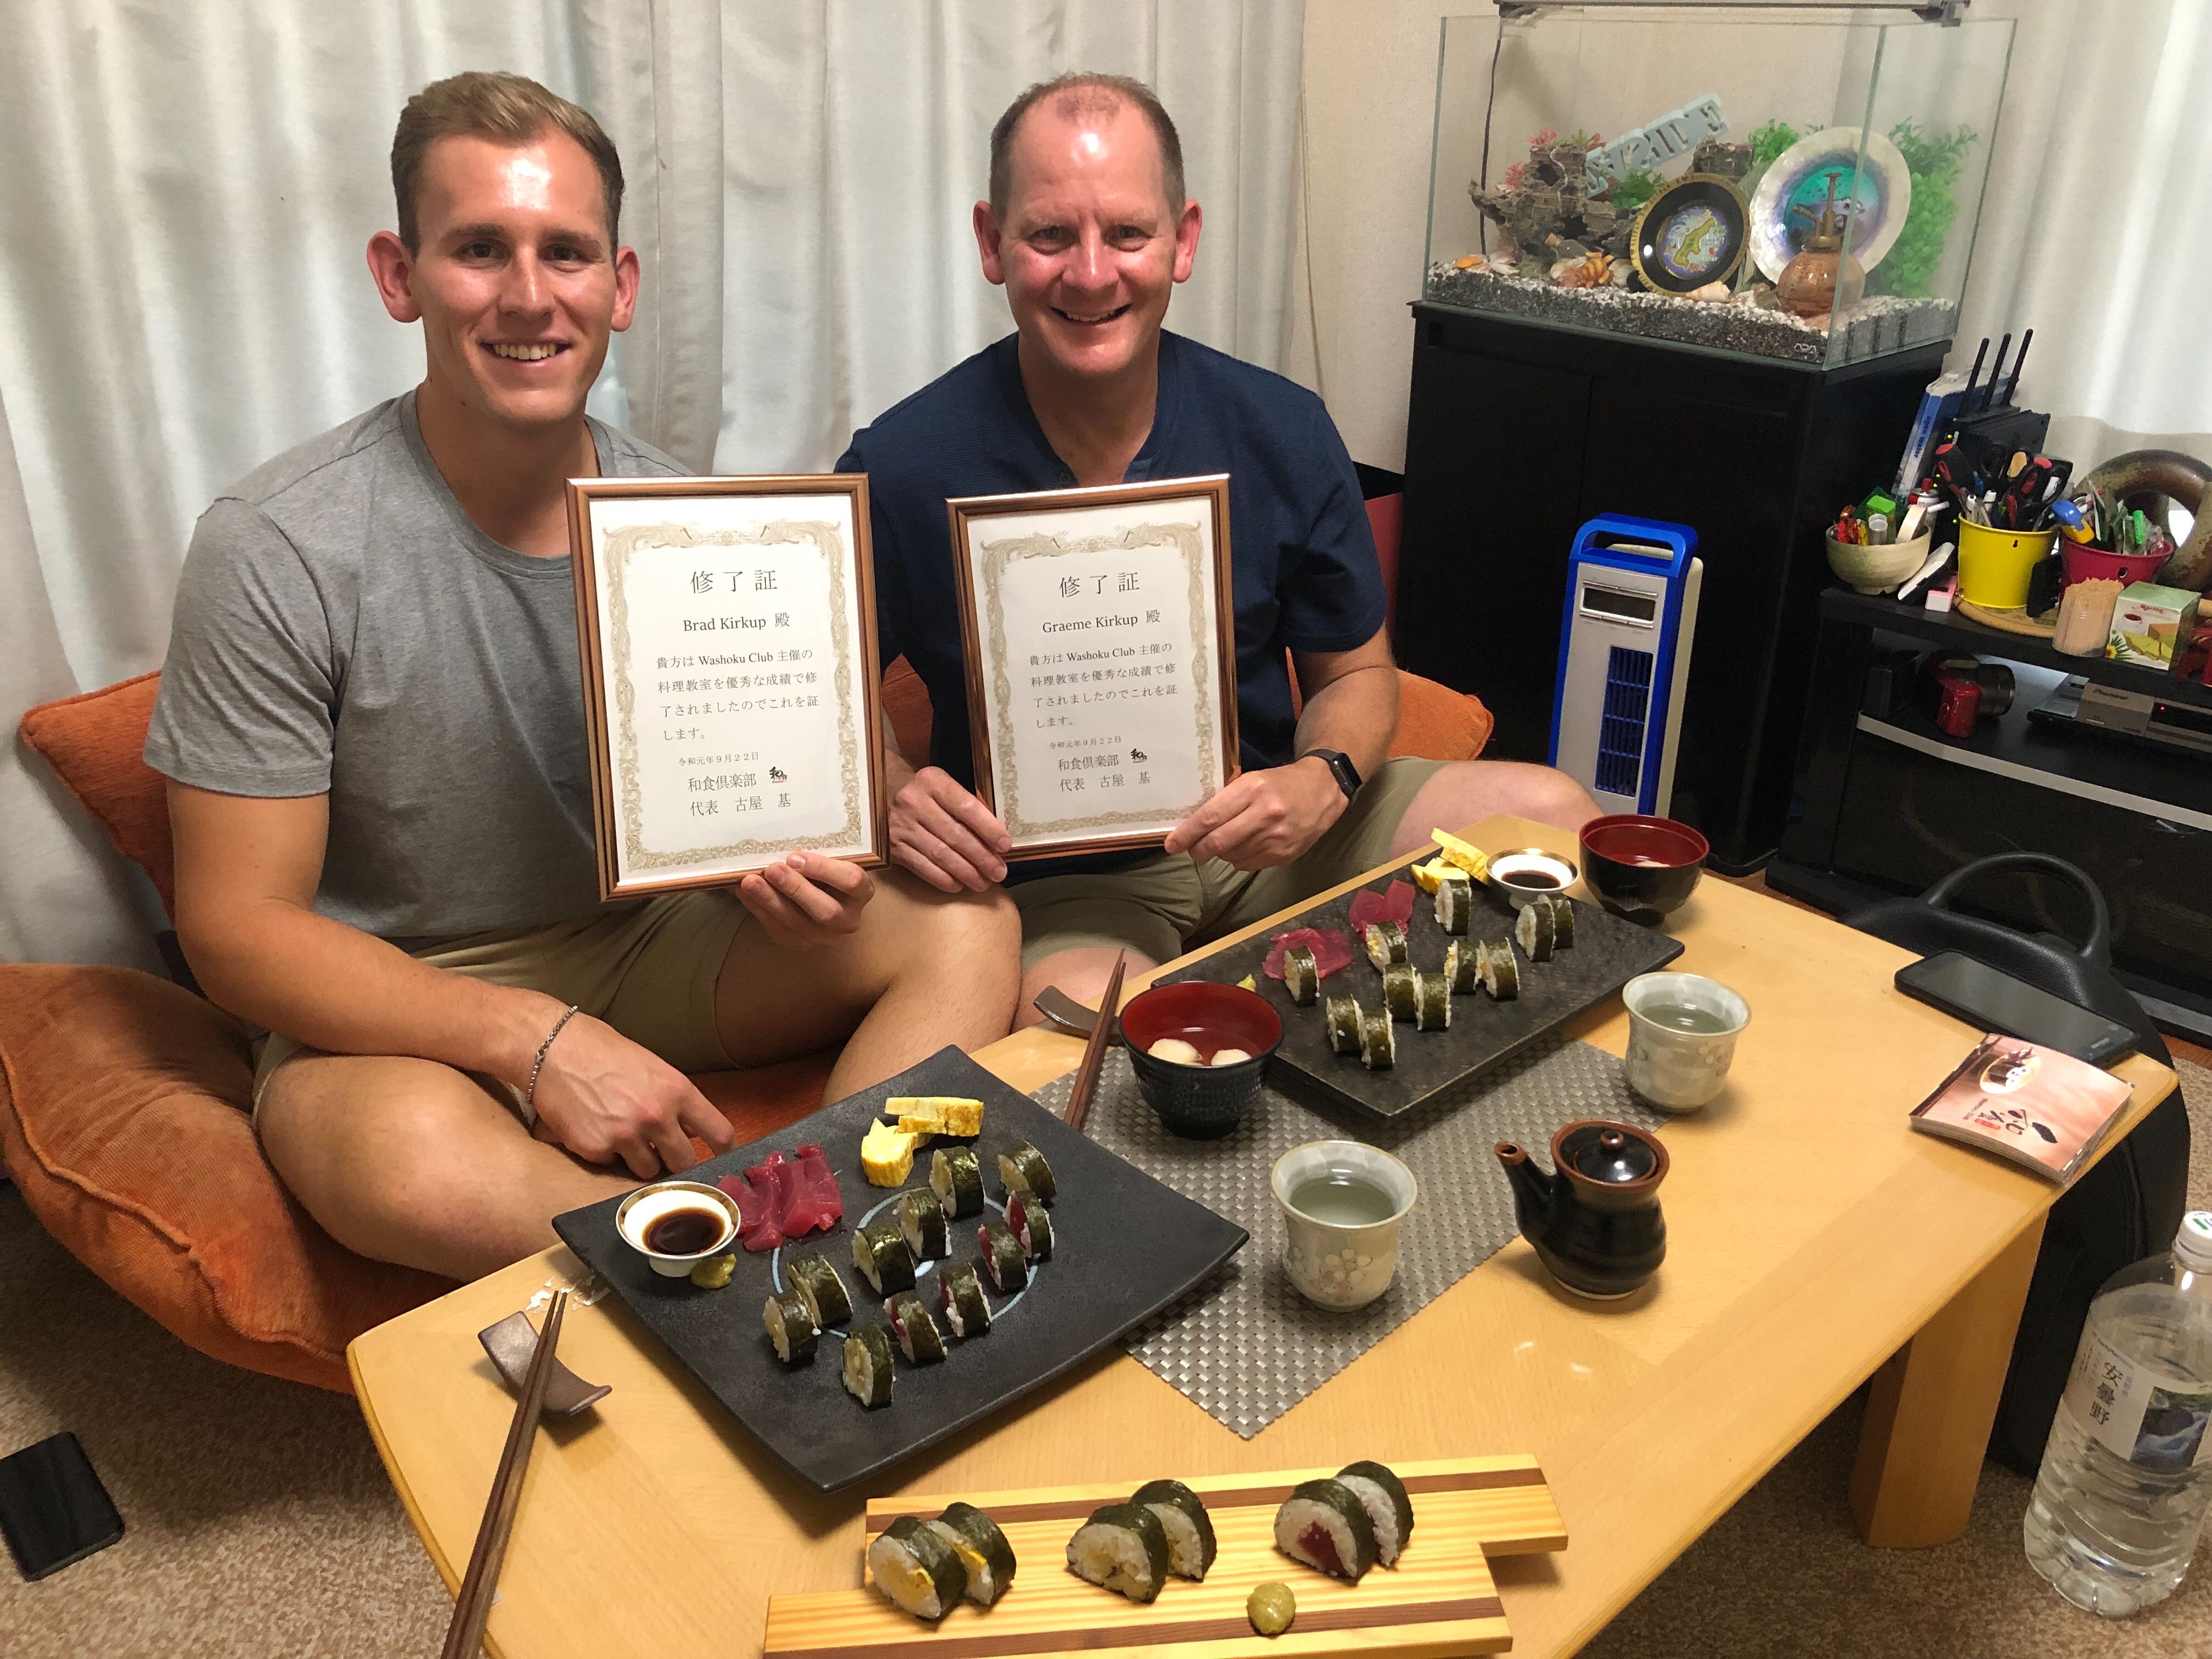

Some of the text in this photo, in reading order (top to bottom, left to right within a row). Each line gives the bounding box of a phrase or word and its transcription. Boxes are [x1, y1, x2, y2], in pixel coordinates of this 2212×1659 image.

[690, 569, 778, 594] 修了証
[1059, 572, 1140, 598] 修了証
[683, 612, 790, 631] Brad Kirkup 殿
[1042, 609, 1161, 633] Graeme Kirkup 殿
[656, 649, 813, 669] 貴方は Washoku Club 主催の
[1029, 643, 1172, 667] 貴方は Washoku Club 主催の
[657, 671, 817, 694] 料理教室を優秀な成績で修
[1030, 662, 1176, 688] 料理教室を優秀な成績で修
[1033, 684, 1179, 708] 了されましたのでこれを証
[2092, 688, 2129, 701] Pioneer
[660, 695, 820, 718] 了されましたのでこれを証
[1036, 715, 1073, 729] します。
[663, 727, 705, 741] します。
[1057, 753, 1120, 772] 和食倶楽部
[686, 772, 757, 793] 和食倶楽部
[1059, 770, 1151, 793] 代表 古屋 基
[689, 792, 791, 817] 代表 古屋 基
